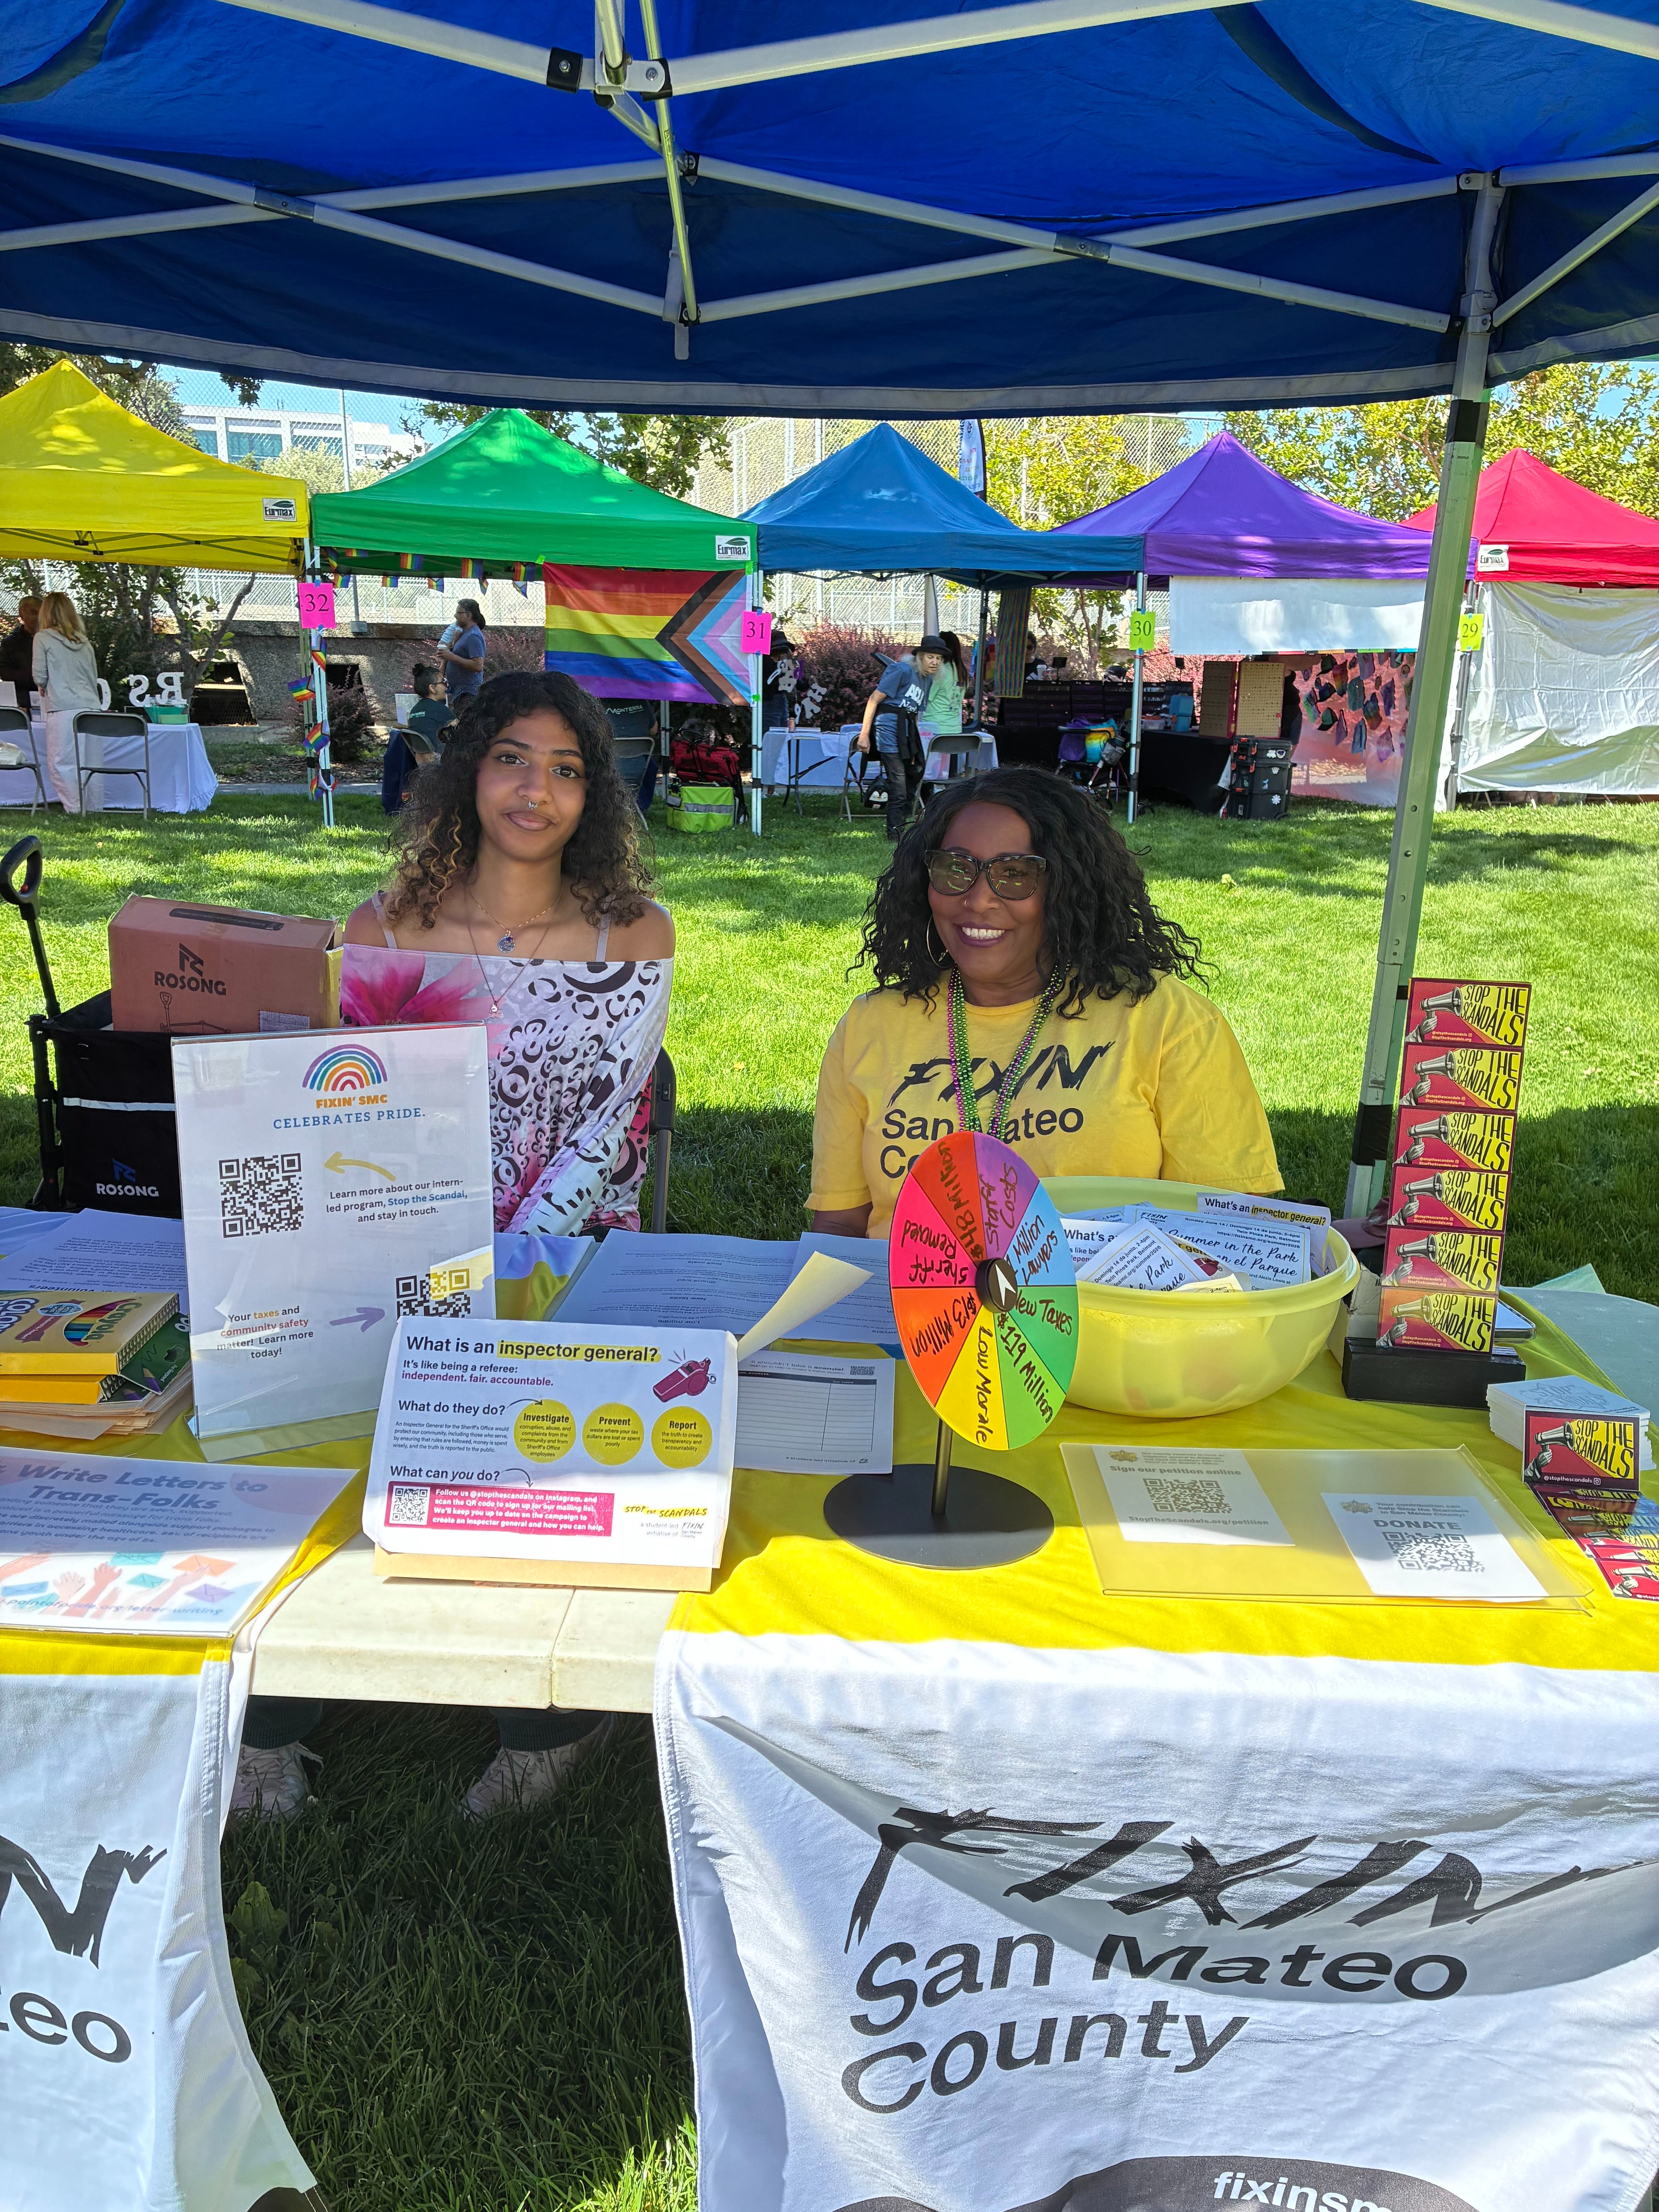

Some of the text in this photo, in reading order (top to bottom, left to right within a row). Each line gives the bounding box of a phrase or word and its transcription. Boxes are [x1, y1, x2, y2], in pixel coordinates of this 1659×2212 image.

[718, 544, 747, 555] Eurmax
[305, 594, 330, 612] 32
[745, 621, 765, 639] 31
[1133, 620, 1151, 636] 30
[1462, 623, 1478, 638] 29
[155, 972, 226, 996] ROSONG
[1465, 985, 1527, 1016] STOP THE
[1461, 1001, 1523, 1045] SCANDALS
[1458, 1049, 1519, 1080] STOP THE
[1455, 1066, 1517, 1108] SCANDALS
[316, 1094, 388, 1109] FIXIN' SMC
[273, 1108, 425, 1129] CELEBRATES PRIDE.
[882, 1109, 953, 1140] San
[1451, 1113, 1512, 1143] STOP THE
[1447, 1129, 1509, 1170] SCANDALS
[96, 1183, 159, 1197] ROSONG
[330, 1191, 357, 1199] Learn
[359, 1188, 383, 1196] more
[385, 1183, 413, 1193] about
[433, 1180, 463, 1188] intern-
[1445, 1171, 1506, 1201] STOP THE
[326, 1190, 467, 1213] led program, Stop the Scandal,
[1205, 1197, 1237, 1211] What's
[1290, 1213, 1326, 1226] general?
[1442, 1187, 1504, 1229] SCANDALS
[358, 1206, 439, 1222] and stay in touch.
[1013, 1215, 1044, 1264] Million
[1064, 1229, 1104, 1242] What's
[1022, 1230, 1058, 1285] Lawyers
[1225, 1241, 1239, 1251] in
[1242, 1244, 1262, 1255] the
[1267, 1247, 1299, 1262] Park
[1439, 1233, 1499, 1263] STOP THE
[1251, 1258, 1297, 1276] Parque
[1436, 1249, 1497, 1291] SCANDALS
[228, 1305, 300, 1322] Your taxes and
[1039, 1299, 1072, 1336] Taxes
[1433, 1294, 1493, 1323] STOP THE
[83, 1302, 142, 1340] Crayola
[220, 1317, 309, 1337] community safety
[1430, 1310, 1490, 1351] SCANDALS
[216, 1331, 313, 1351] matter! Learn more
[407, 1336, 658, 1362] What is an inspector general?
[978, 1325, 993, 1369] Low
[251, 1347, 282, 1359] today!
[404, 1360, 418, 1369] It's
[421, 1360, 438, 1369] like
[441, 1361, 468, 1373] being
[479, 1364, 518, 1373] referee:
[402, 1371, 553, 1386] independent. fair. accountable.
[398, 1400, 505, 1417] What do they do?
[523, 1413, 569, 1423] Investigate
[599, 1416, 630, 1426] Prevent
[669, 1421, 697, 1430] Report
[1575, 1420, 1633, 1449] STOP THE
[1575, 1437, 1634, 1478] SCANDALS
[18, 1465, 268, 1493] Write Letters to
[390, 1465, 500, 1481] What can you do?
[1544, 1475, 1592, 1484] @stopthescandals
[29, 1486, 220, 1509] Trans-Folks
[659, 1509, 708, 1517] SCANDALS
[1128, 1516, 1269, 1525] StopTheScandals.org/petition
[1373, 1520, 1462, 1530] DONATE
[843, 1807, 1659, 1954] FIXIN
[850, 1933, 1467, 2036] San Mateo
[842, 2000, 1249, 2114] County
